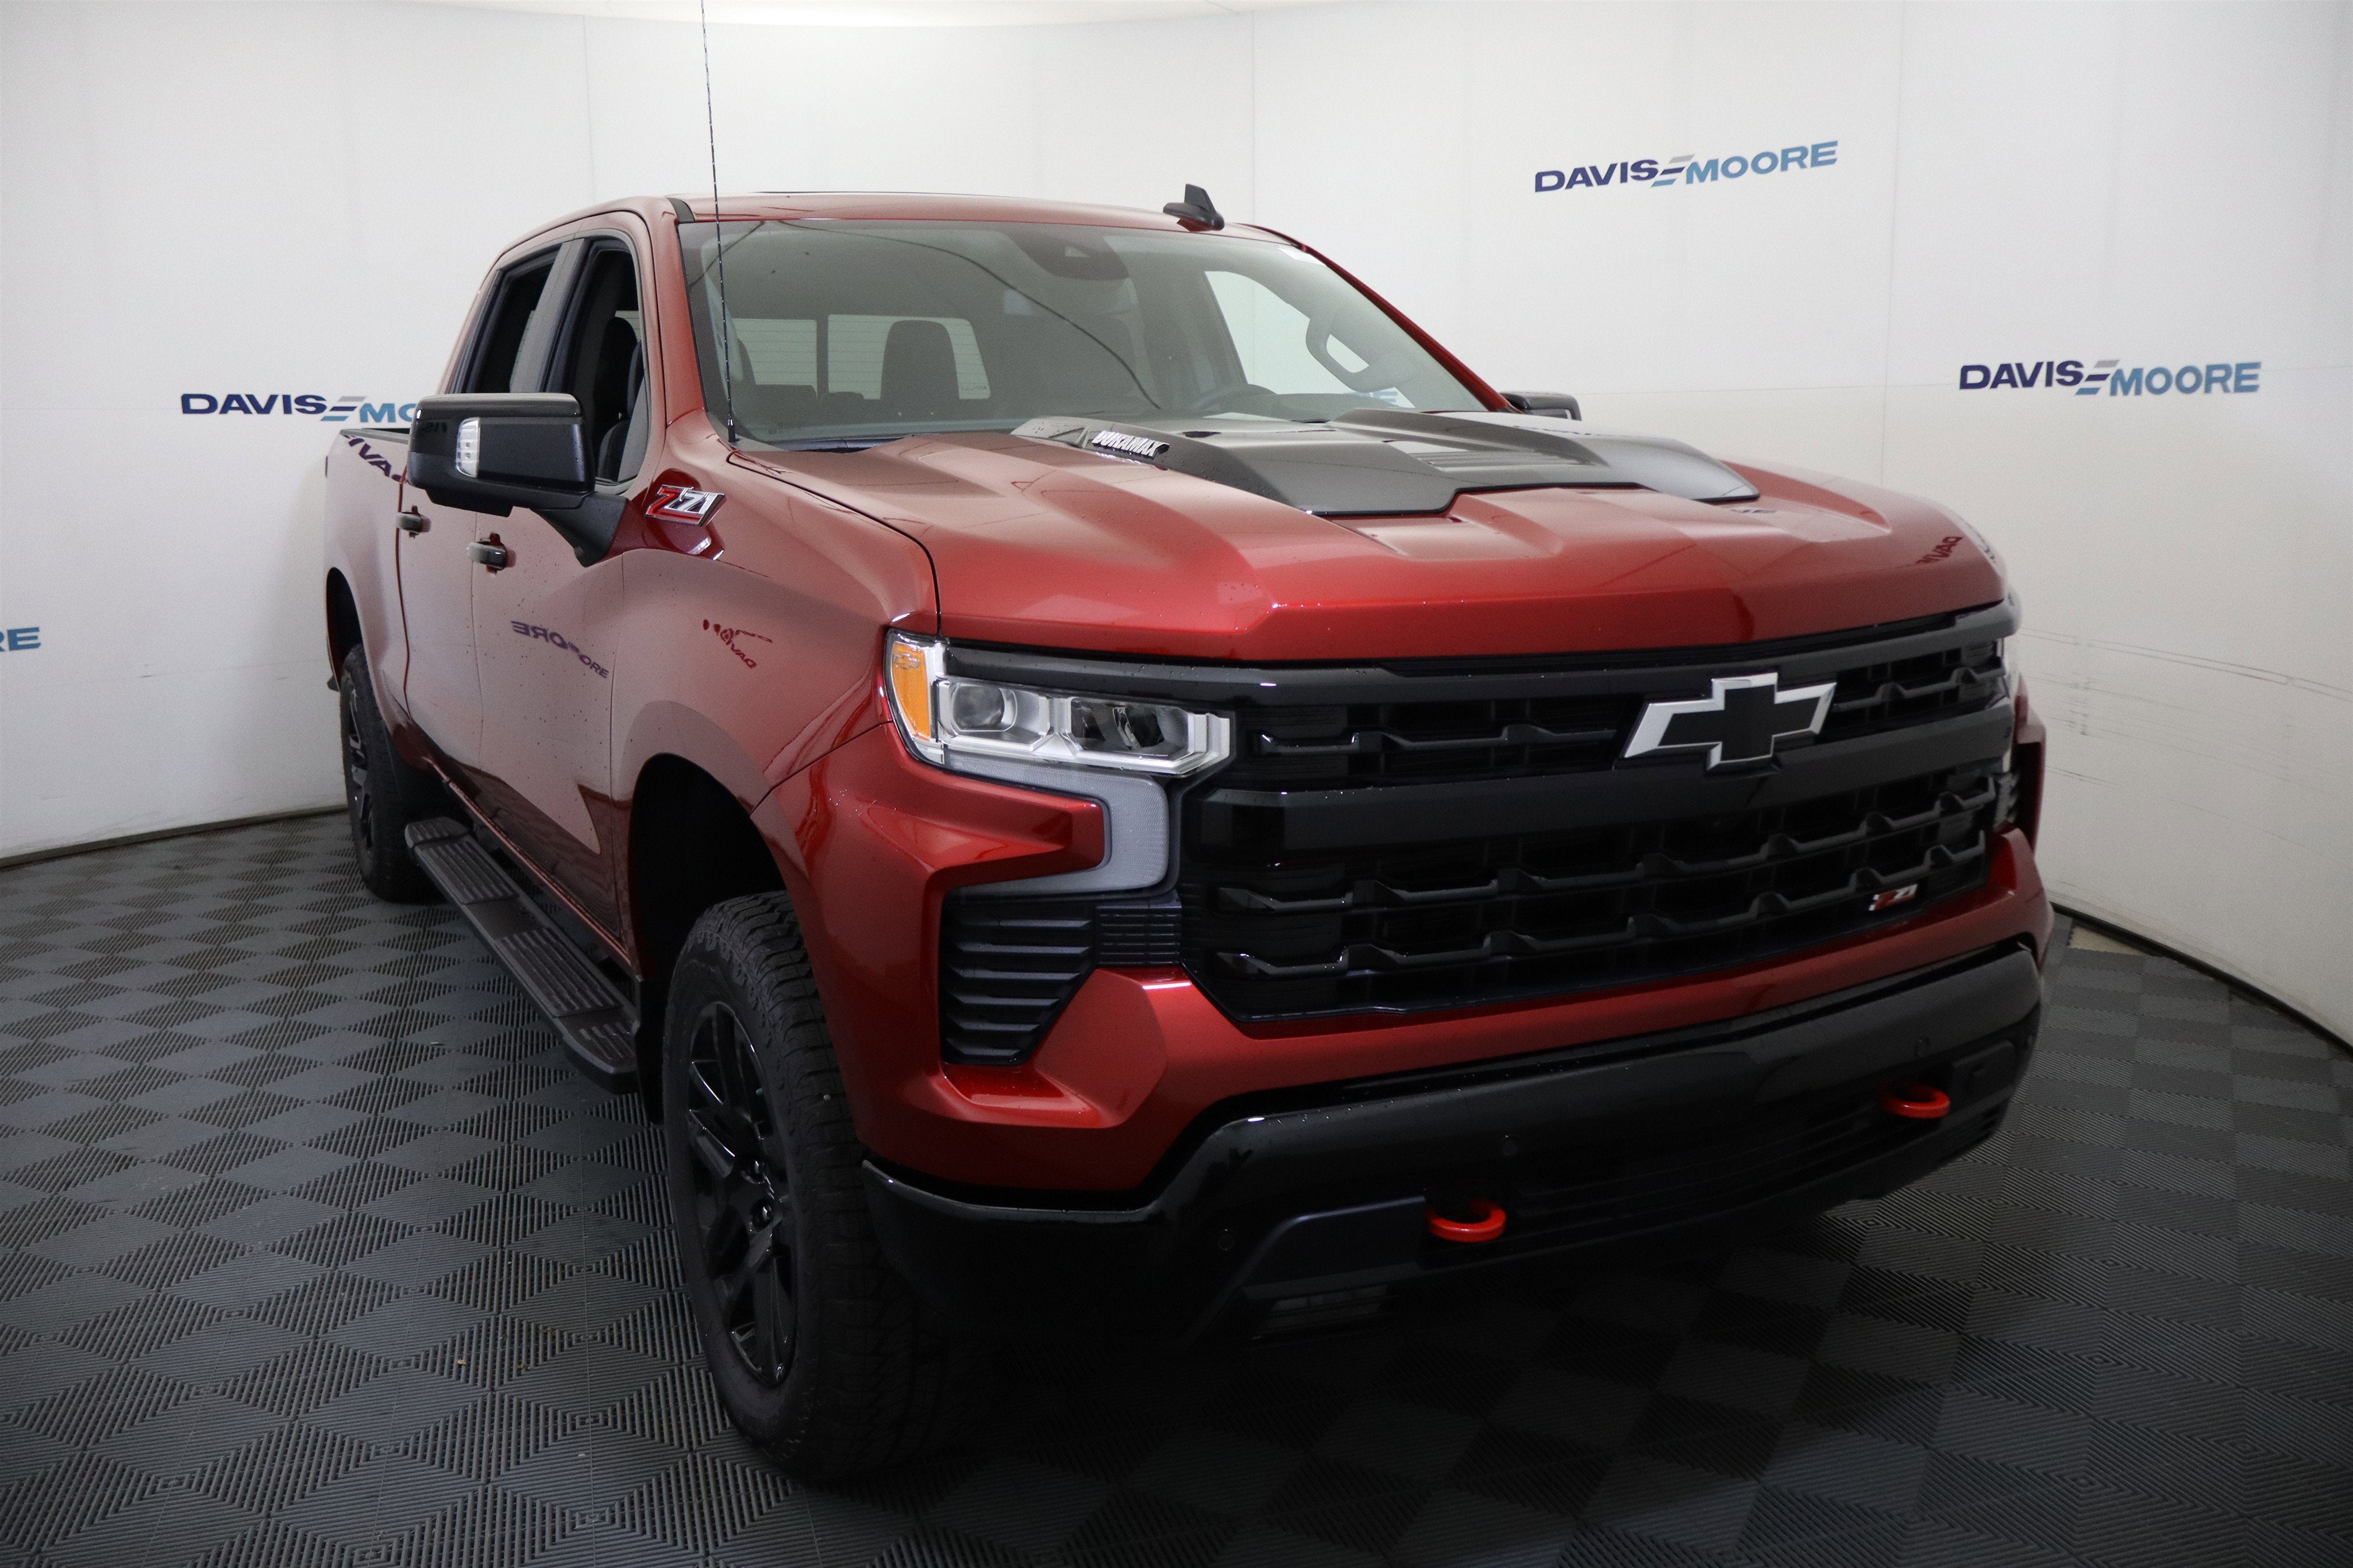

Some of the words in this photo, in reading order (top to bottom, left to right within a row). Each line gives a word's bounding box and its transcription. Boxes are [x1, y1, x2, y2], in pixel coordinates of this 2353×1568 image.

[1535, 159, 1658, 192] DAVIS
[1685, 140, 1838, 184] MOORE
[1959, 360, 2084, 390] DAVIS
[2110, 362, 2262, 396] MOORE
[181, 393, 327, 415] DAVIS
[1091, 430, 1170, 457] DURAMAX
[645, 484, 725, 527] Z71
[0, 627, 41, 652] E
